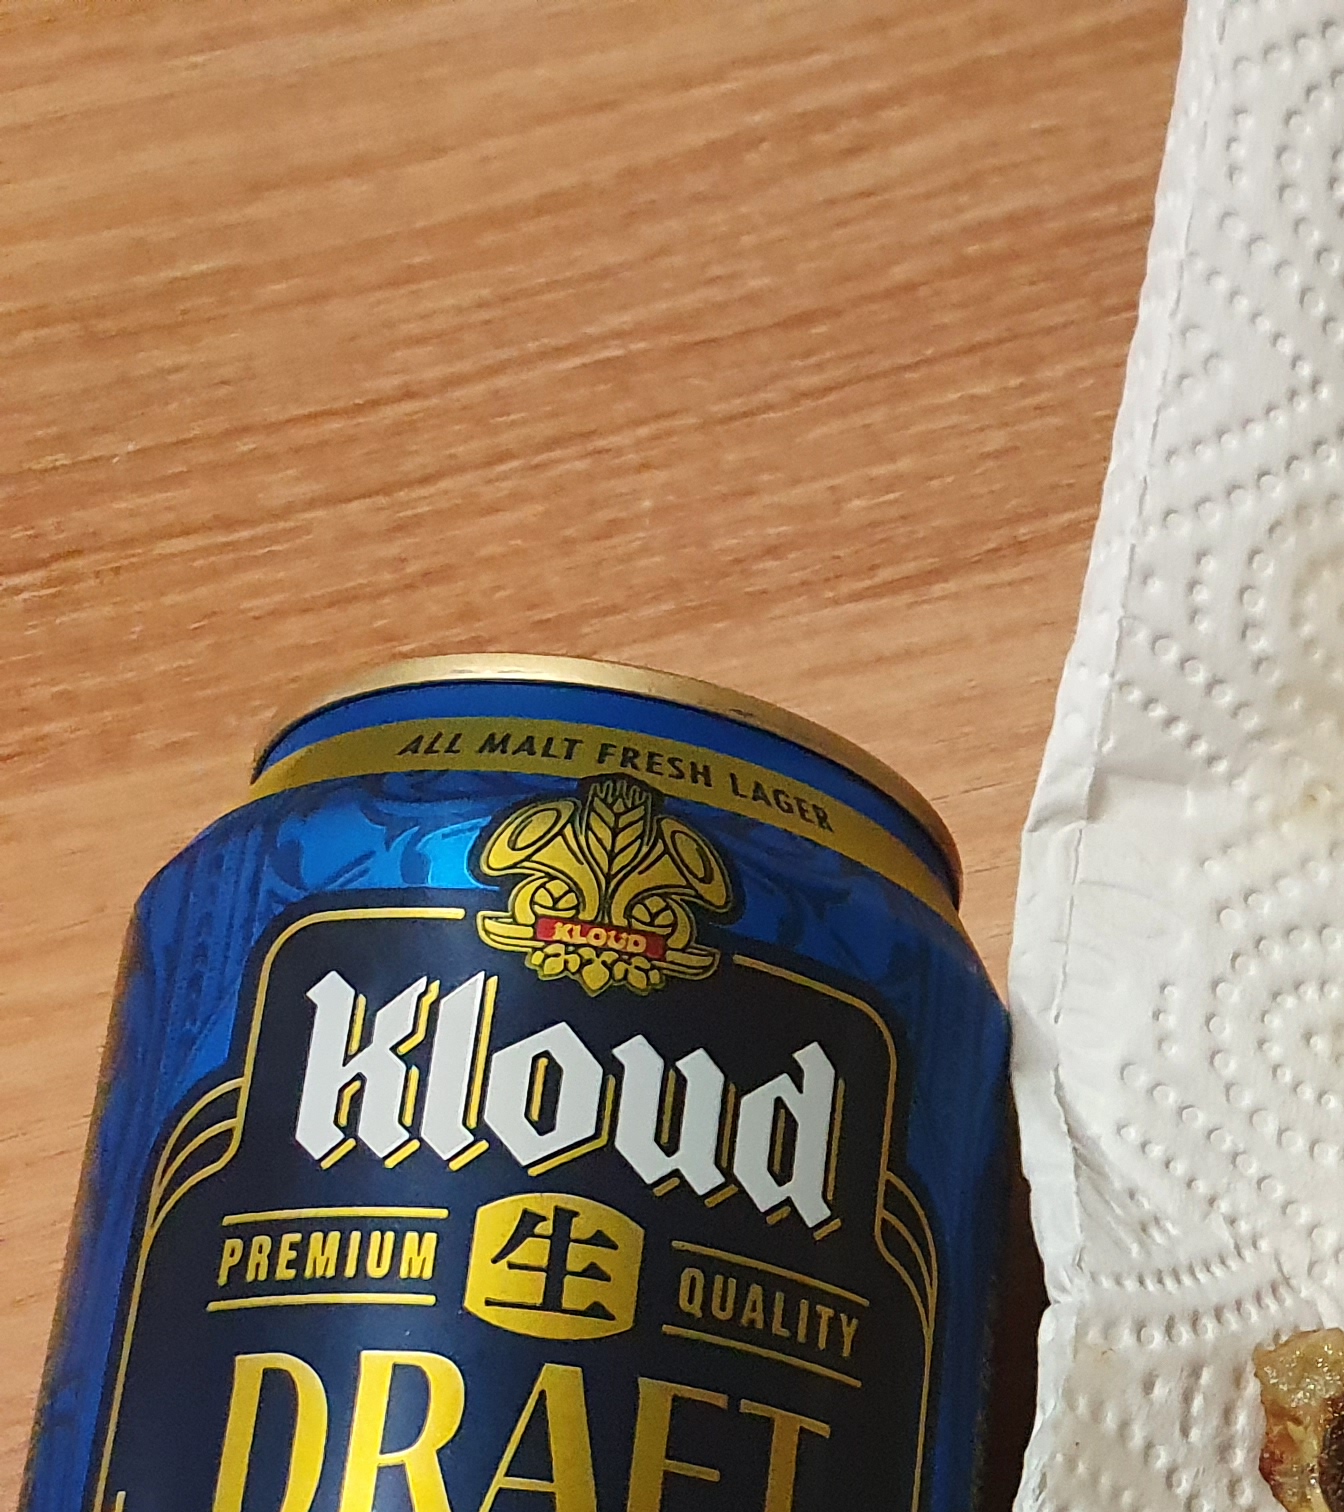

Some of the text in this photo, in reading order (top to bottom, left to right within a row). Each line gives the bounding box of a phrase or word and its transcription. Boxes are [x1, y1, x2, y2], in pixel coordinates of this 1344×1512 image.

[397, 731, 835, 833] ALL MALT FRESH LAGER
[553, 920, 648, 955] KLOUD
[295, 970, 845, 1241] Kloud
[216, 1230, 438, 1287] PREMIUM
[483, 1204, 621, 1320] 生
[678, 1267, 863, 1358] QUALITY
